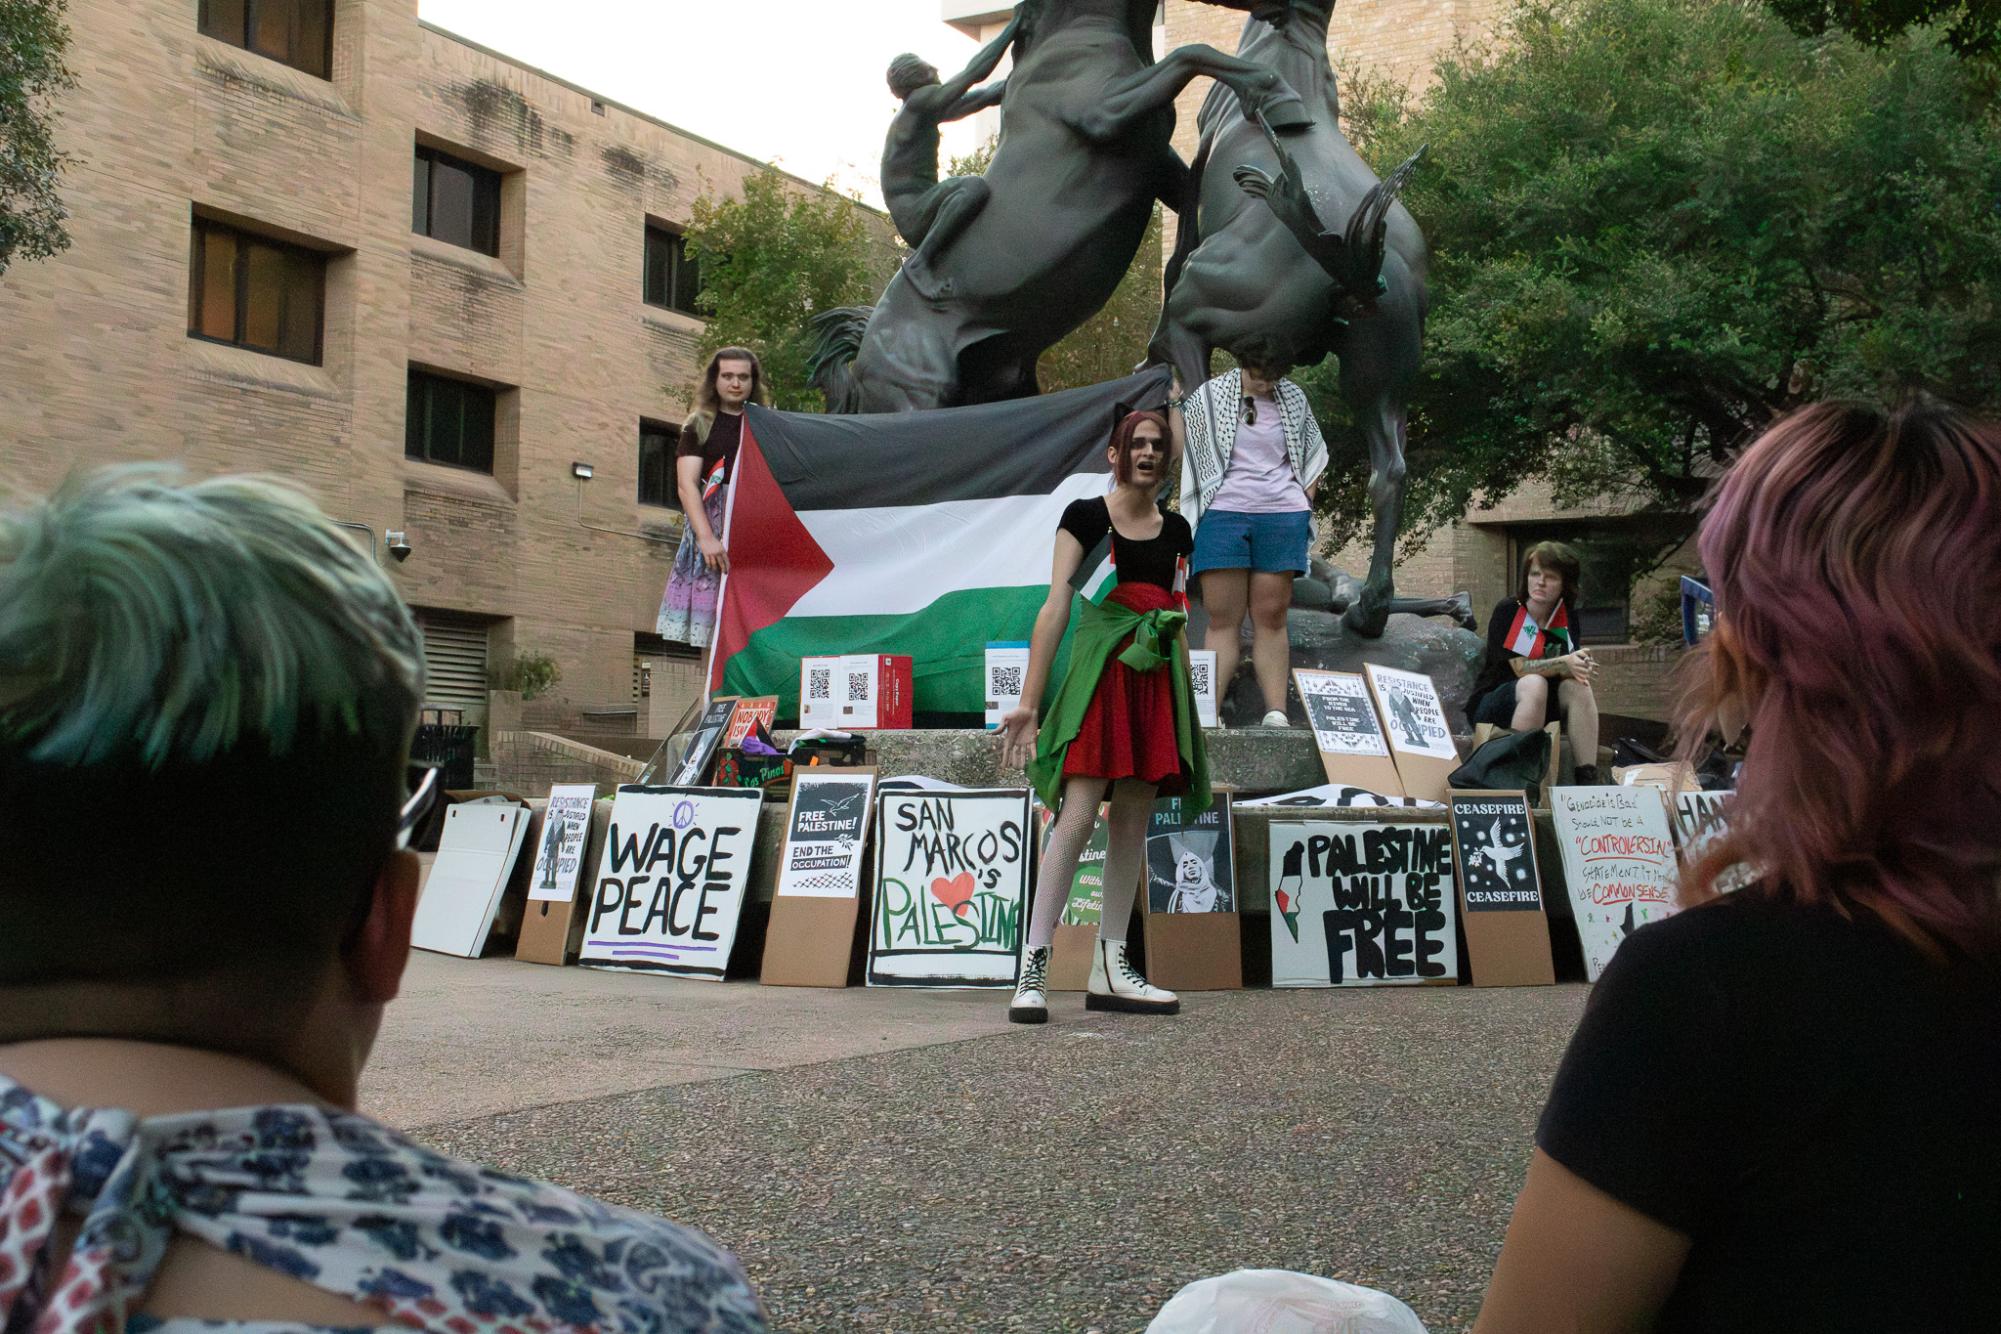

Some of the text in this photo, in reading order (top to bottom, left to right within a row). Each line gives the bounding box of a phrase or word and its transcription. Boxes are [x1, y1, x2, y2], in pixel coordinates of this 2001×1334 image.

[1413, 697, 1430, 706] WHEN
[737, 709, 771, 723] NOBDY
[1391, 720, 1446, 738] OCPIED
[800, 810, 826, 821] FREE
[896, 798, 955, 832] SAN
[1454, 804, 1525, 815] CEASEFIRE
[797, 817, 857, 833] PALESTINE!
[1155, 812, 1219, 825] PALINE
[610, 822, 741, 882] WAGE
[792, 845, 834, 857] END THE
[903, 820, 1022, 877] MARCOS
[1308, 827, 1451, 877] PALESTINE
[536, 857, 577, 873] OCPIED
[791, 855, 852, 869] OCCUPATION!
[1332, 871, 1441, 911] WILL BE
[1467, 890, 1538, 902] CEASEFIRE
[590, 875, 731, 941] PEACE
[882, 877, 1024, 950] PALESTINE
[1323, 908, 1446, 984] FREE
